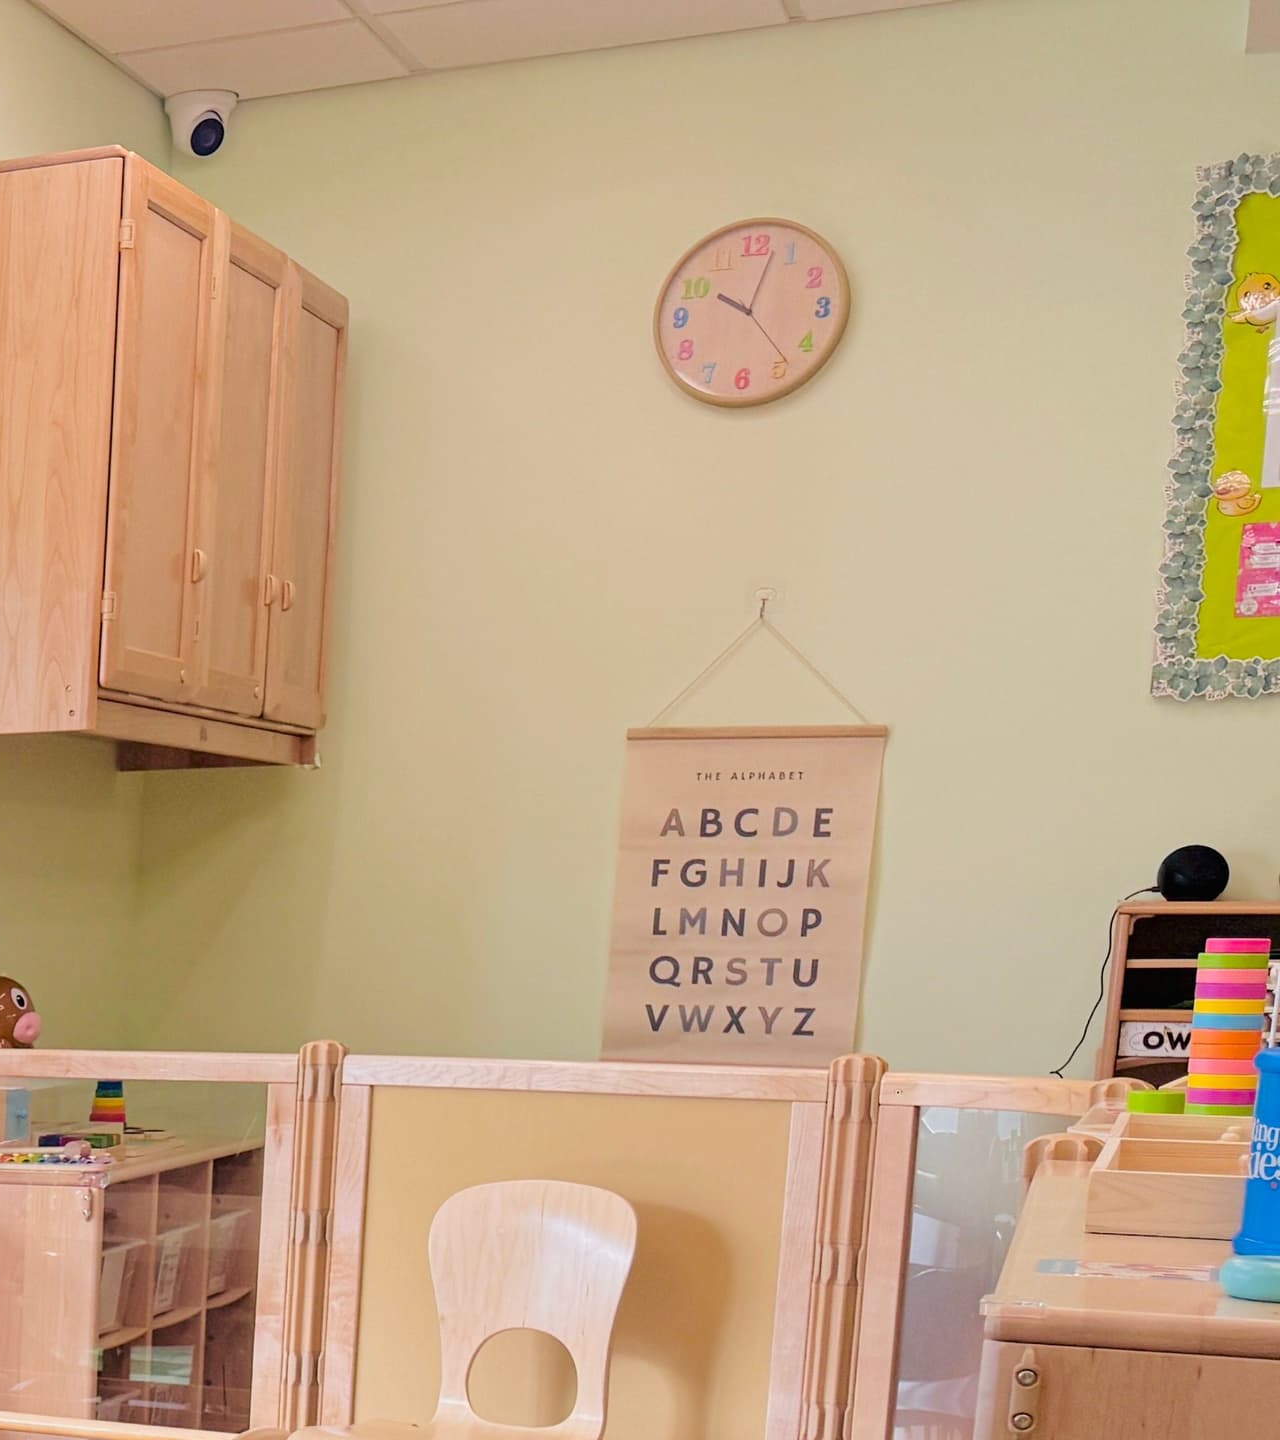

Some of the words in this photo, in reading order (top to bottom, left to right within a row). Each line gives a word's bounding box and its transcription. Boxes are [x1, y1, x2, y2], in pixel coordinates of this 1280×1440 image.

[741, 234, 771, 257] 12
[784, 240, 797, 265] 1
[682, 277, 711, 300] 10
[806, 266, 824, 289] 2
[673, 307, 689, 329] 9
[815, 296, 831, 318] 3
[677, 339, 694, 361] 8
[798, 331, 814, 352] 4
[702, 362, 717, 384] 7
[735, 368, 750, 390] 6
[696, 772, 722, 781] THE
[730, 771, 805, 781] ALPHABET
